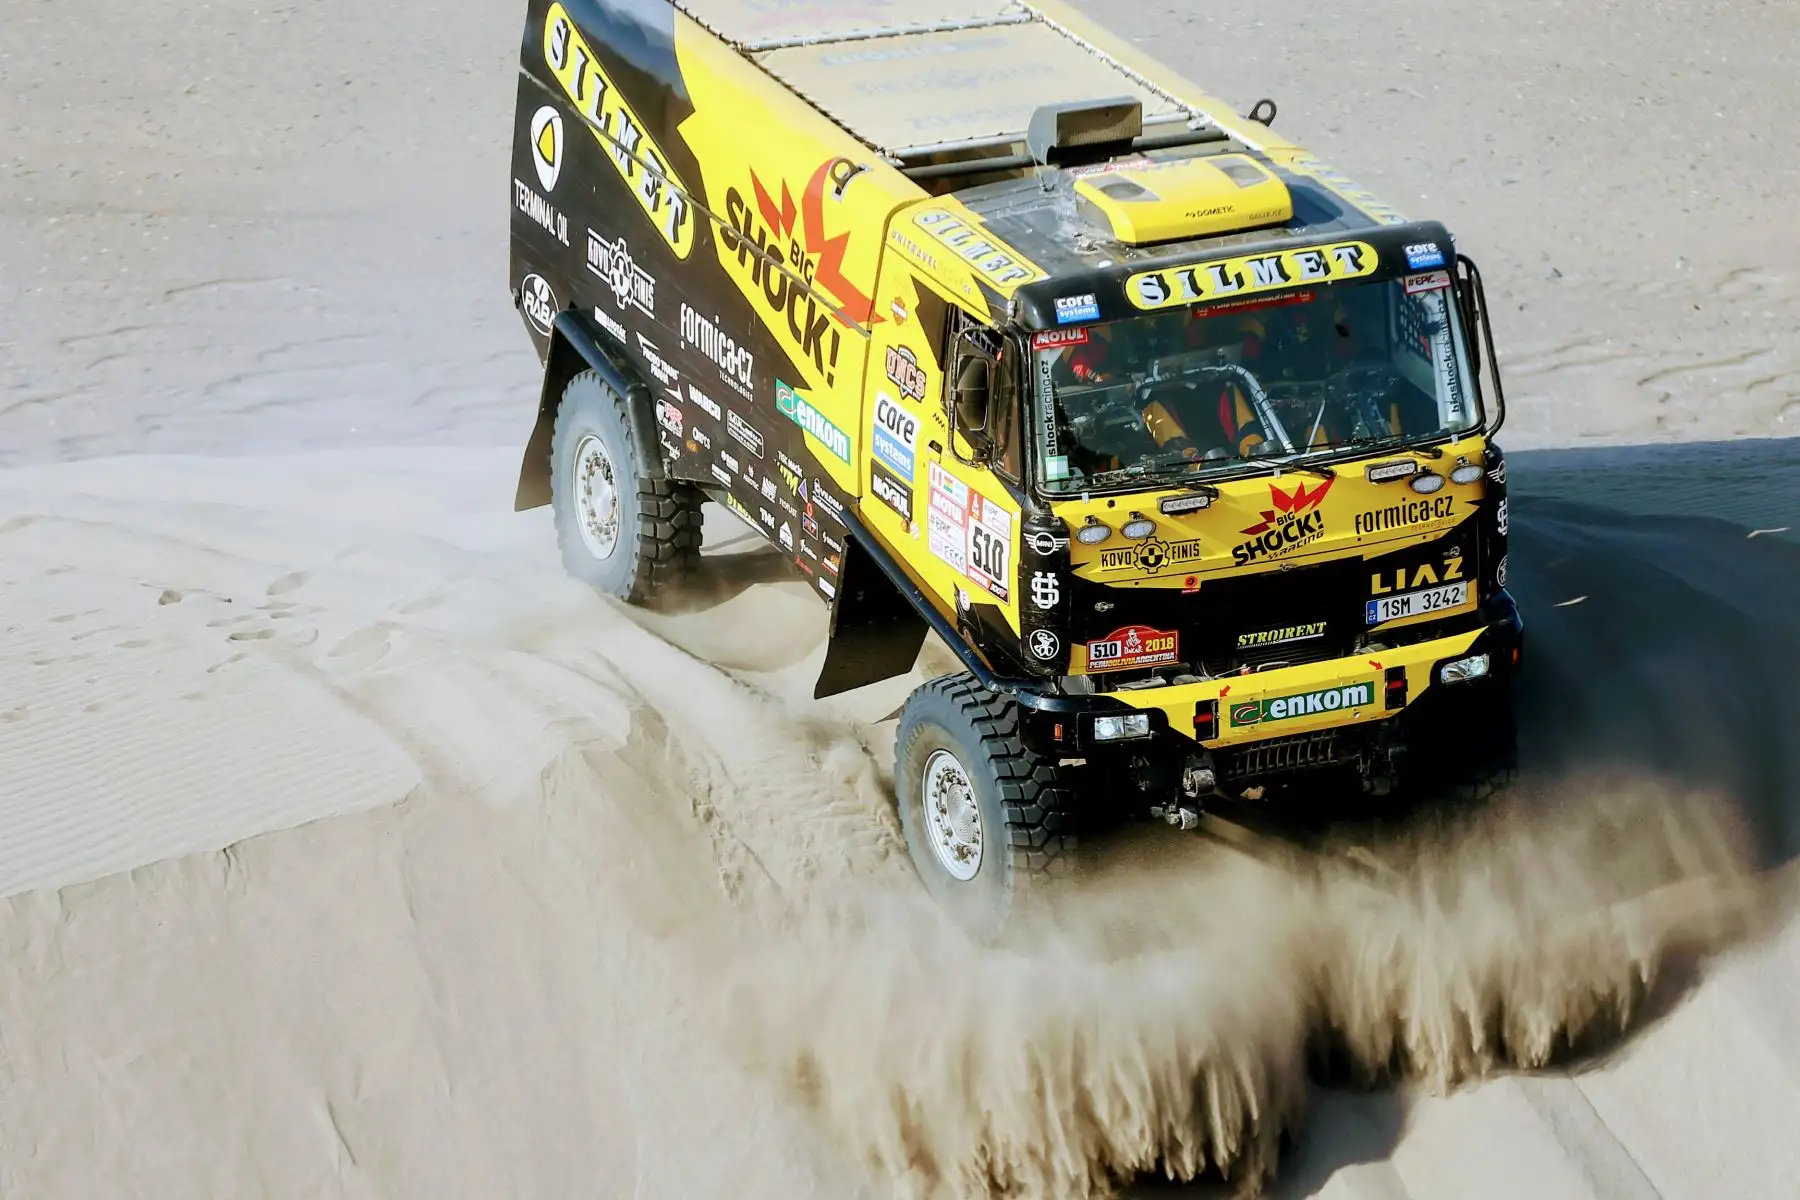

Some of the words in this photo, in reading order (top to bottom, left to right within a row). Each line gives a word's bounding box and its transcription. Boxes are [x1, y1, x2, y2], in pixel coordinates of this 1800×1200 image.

[551, 18, 688, 243] SILMET
[514, 178, 556, 236] TERMINAL
[557, 212, 570, 247] OIL
[1197, 205, 1236, 218] DOMETIC
[789, 238, 814, 286] BIG
[1406, 243, 1437, 255] core
[588, 235, 609, 274] KOVO
[633, 273, 655, 311] FINIS
[720, 186, 840, 389] SHOCK!
[1137, 246, 1364, 306] SILMET
[1056, 294, 1094, 309] core
[1059, 306, 1096, 318] systems
[1036, 327, 1084, 345] MOTUL
[688, 383, 722, 422] WABCO
[796, 400, 848, 462] enkom
[877, 399, 915, 444] core
[875, 434, 912, 471] systems
[872, 473, 911, 520] MOGUL
[1276, 511, 1295, 527] BIG
[972, 525, 1004, 581] 510
[1036, 540, 1053, 548] MINI
[1101, 551, 1132, 567] KOVO
[1172, 543, 1200, 560] FINIS
[1231, 510, 1325, 567] SHOCK!
[1382, 596, 1411, 618] 1SM
[1422, 587, 1460, 610] 3242
[1094, 642, 1118, 659] 510
[1145, 636, 1175, 652] 2018
[1269, 684, 1368, 719] enkom
